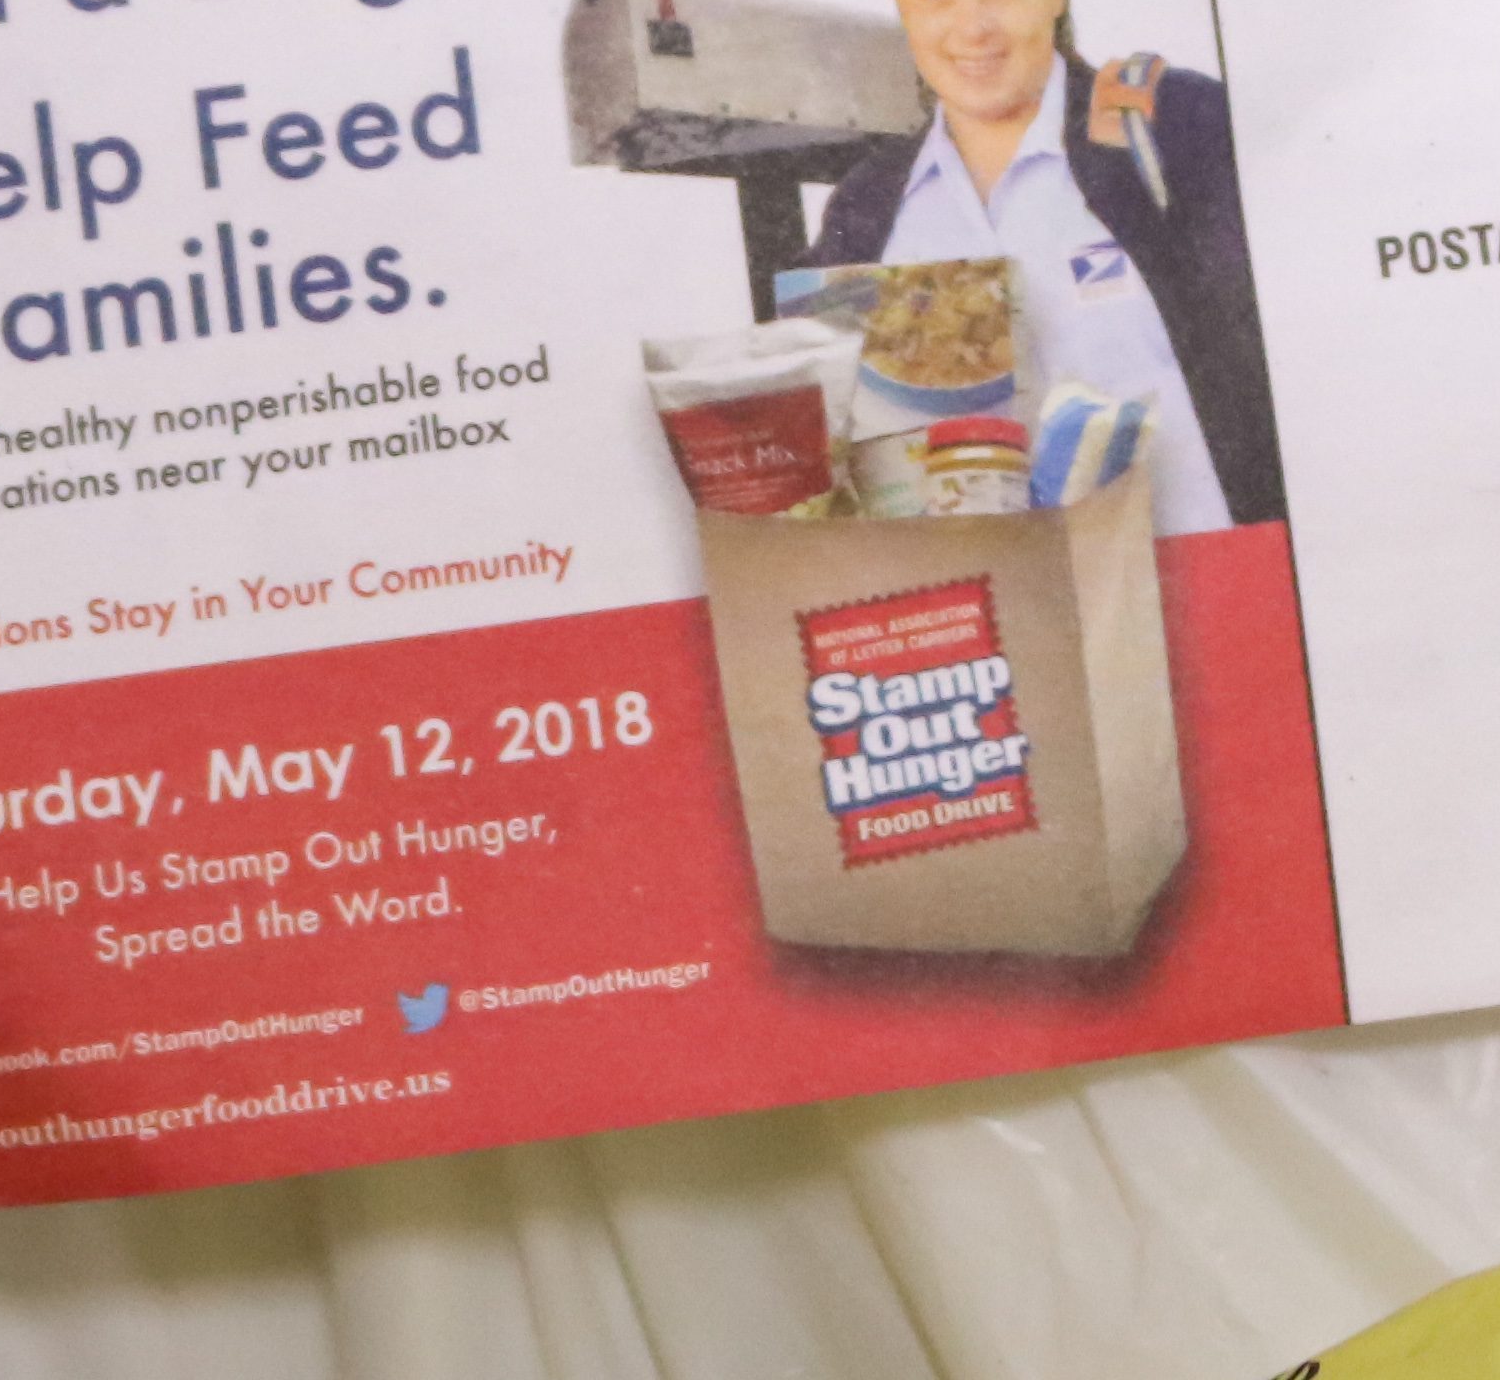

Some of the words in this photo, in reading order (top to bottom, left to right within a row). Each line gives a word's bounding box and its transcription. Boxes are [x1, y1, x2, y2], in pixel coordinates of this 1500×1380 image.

[194, 45, 483, 190] Feed
[152, 362, 441, 436] nonperishable
[454, 344, 550, 395] food
[134, 454, 225, 493] near
[240, 440, 331, 488] your
[347, 409, 512, 465] mailbox
[87, 595, 176, 638] Stay
[190, 585, 228, 620] in
[237, 571, 333, 614] Your
[347, 539, 574, 599] Community
[811, 655, 1010, 726] Stamp
[861, 701, 982, 758] Out
[206, 742, 355, 806] May
[380, 720, 476, 782] 12,
[495, 690, 654, 765] 2018
[824, 734, 1029, 805] Hunger
[93, 860, 147, 899] Us
[161, 843, 290, 894] Stamp
[305, 828, 383, 871] Out
[396, 809, 559, 865] Hunger,
[858, 809, 931, 841] FOOD
[933, 791, 1015, 826] DRIVE
[94, 913, 244, 971] Spread
[256, 898, 320, 941] the
[333, 882, 463, 927] Word.
[458, 958, 712, 1014] @StampOutHunger
